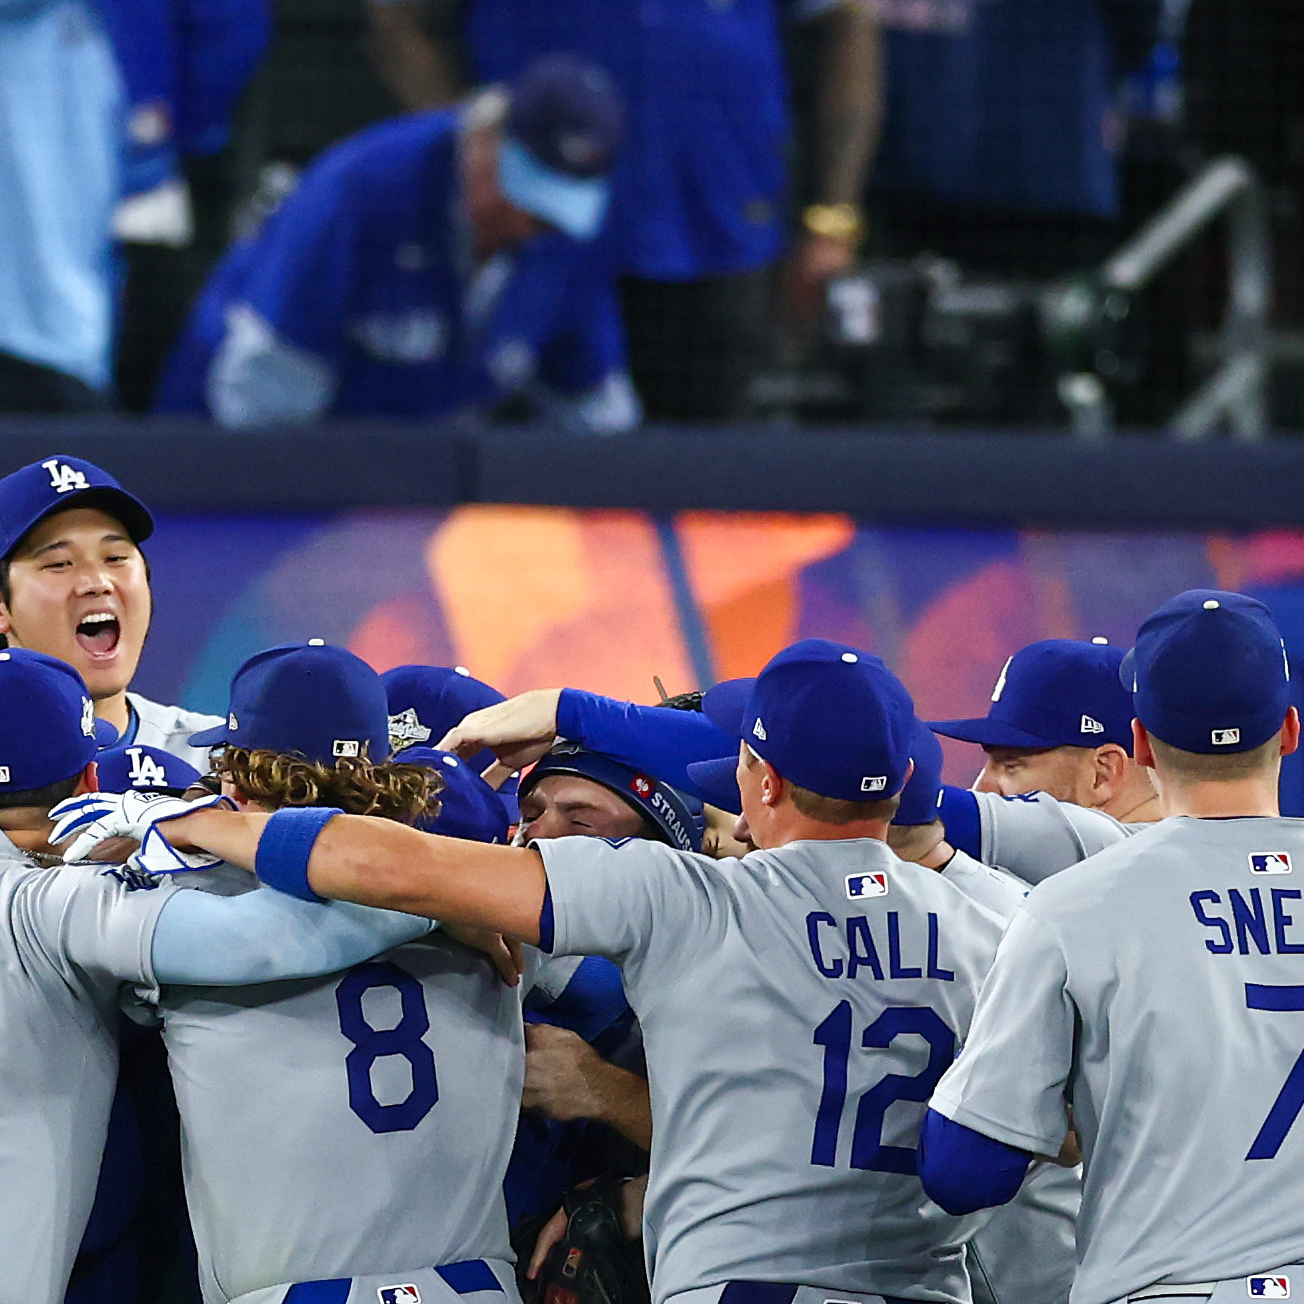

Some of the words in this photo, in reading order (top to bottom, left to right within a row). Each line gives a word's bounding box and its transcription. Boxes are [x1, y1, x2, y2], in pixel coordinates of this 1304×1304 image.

[41, 459, 91, 494] LA
[125, 747, 168, 787] LA
[806, 910, 955, 981] CALL
[335, 962, 439, 1134] 8
[811, 1000, 956, 1174] 12
